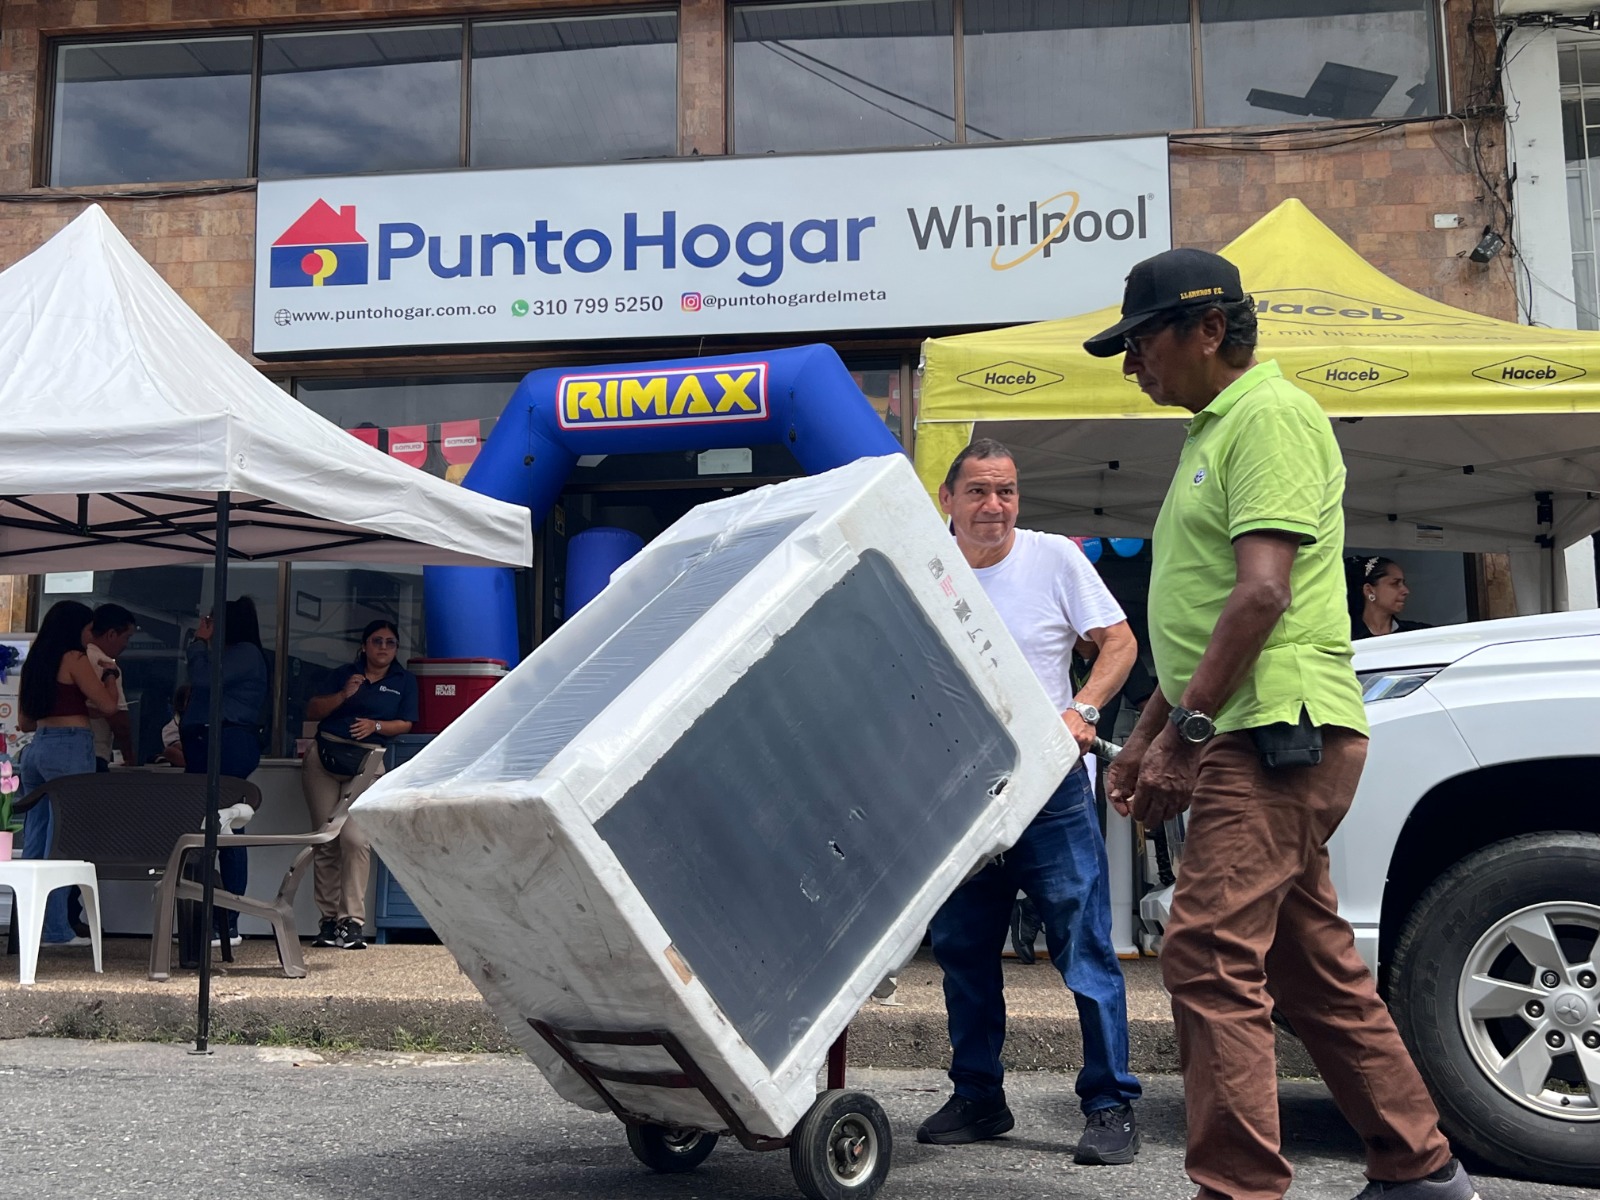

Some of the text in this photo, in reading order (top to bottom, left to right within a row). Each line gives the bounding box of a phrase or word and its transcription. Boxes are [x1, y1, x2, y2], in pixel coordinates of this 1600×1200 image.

[906, 194, 1147, 258] Whirlpool
[533, 295, 664, 316] 310 799 5250
[702, 289, 887, 310] @puntohogardelmeta
[292, 304, 497, 322] www.puntohogar.com.co
[1323, 330, 1425, 339] historias
[984, 371, 1037, 385] Haceb
[1325, 367, 1380, 382] Haceb
[1501, 365, 1557, 381] Haceb
[566, 370, 758, 421] RIMAX
